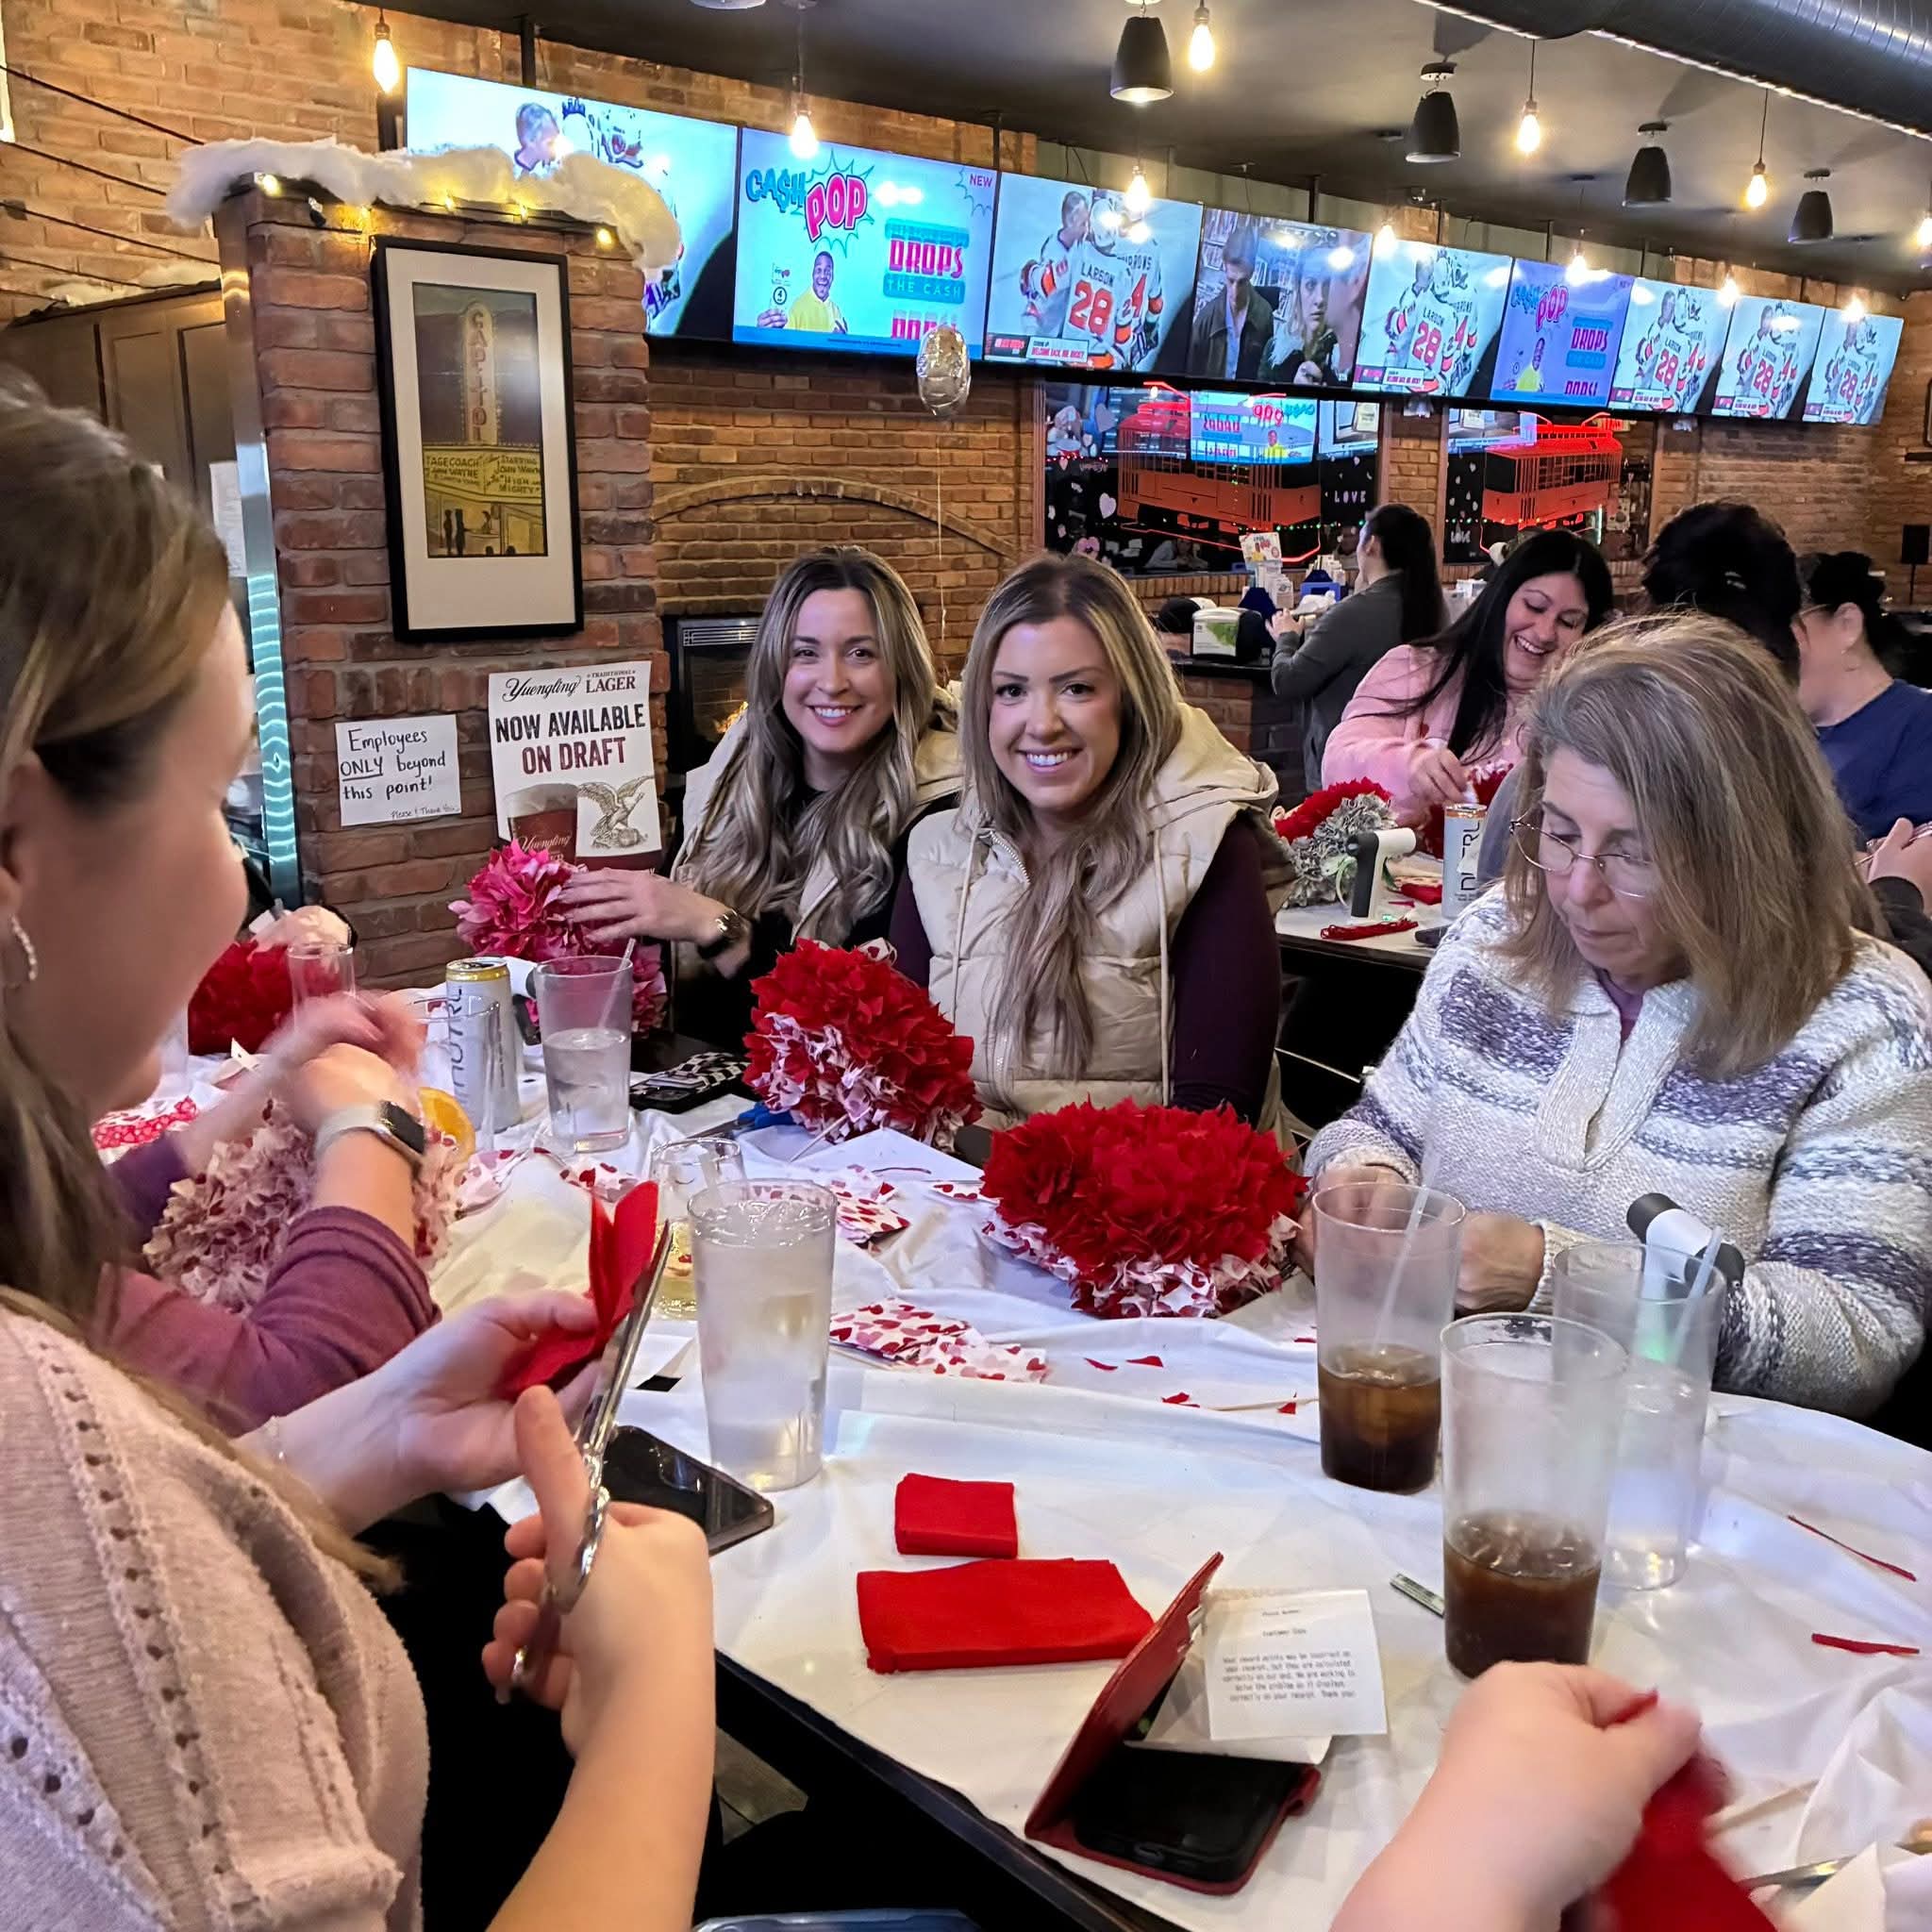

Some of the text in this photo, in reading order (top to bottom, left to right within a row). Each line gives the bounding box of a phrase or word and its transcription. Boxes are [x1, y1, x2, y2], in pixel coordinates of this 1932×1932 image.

[969, 174, 992, 188] NEW
[745, 168, 868, 242] CASH POP
[889, 238, 964, 279] DROPS
[888, 277, 962, 298] THE CASH
[1068, 278, 1114, 336] 28
[1535, 284, 1569, 332] POP
[1412, 320, 1442, 366] 28
[1570, 326, 1608, 352] DROPS
[1655, 348, 1680, 387] 28
[1752, 358, 1774, 394] 28
[1840, 367, 1858, 402] 28
[1333, 490, 1367, 504] LOVE
[502, 675, 637, 703] Yuengling LAGER
[495, 703, 646, 743] NOW AVAILABLE
[348, 727, 428, 755] Employees
[522, 736, 626, 774] ON DRAFT
[341, 751, 446, 778] ONLY beyond
[342, 785, 373, 800] this
